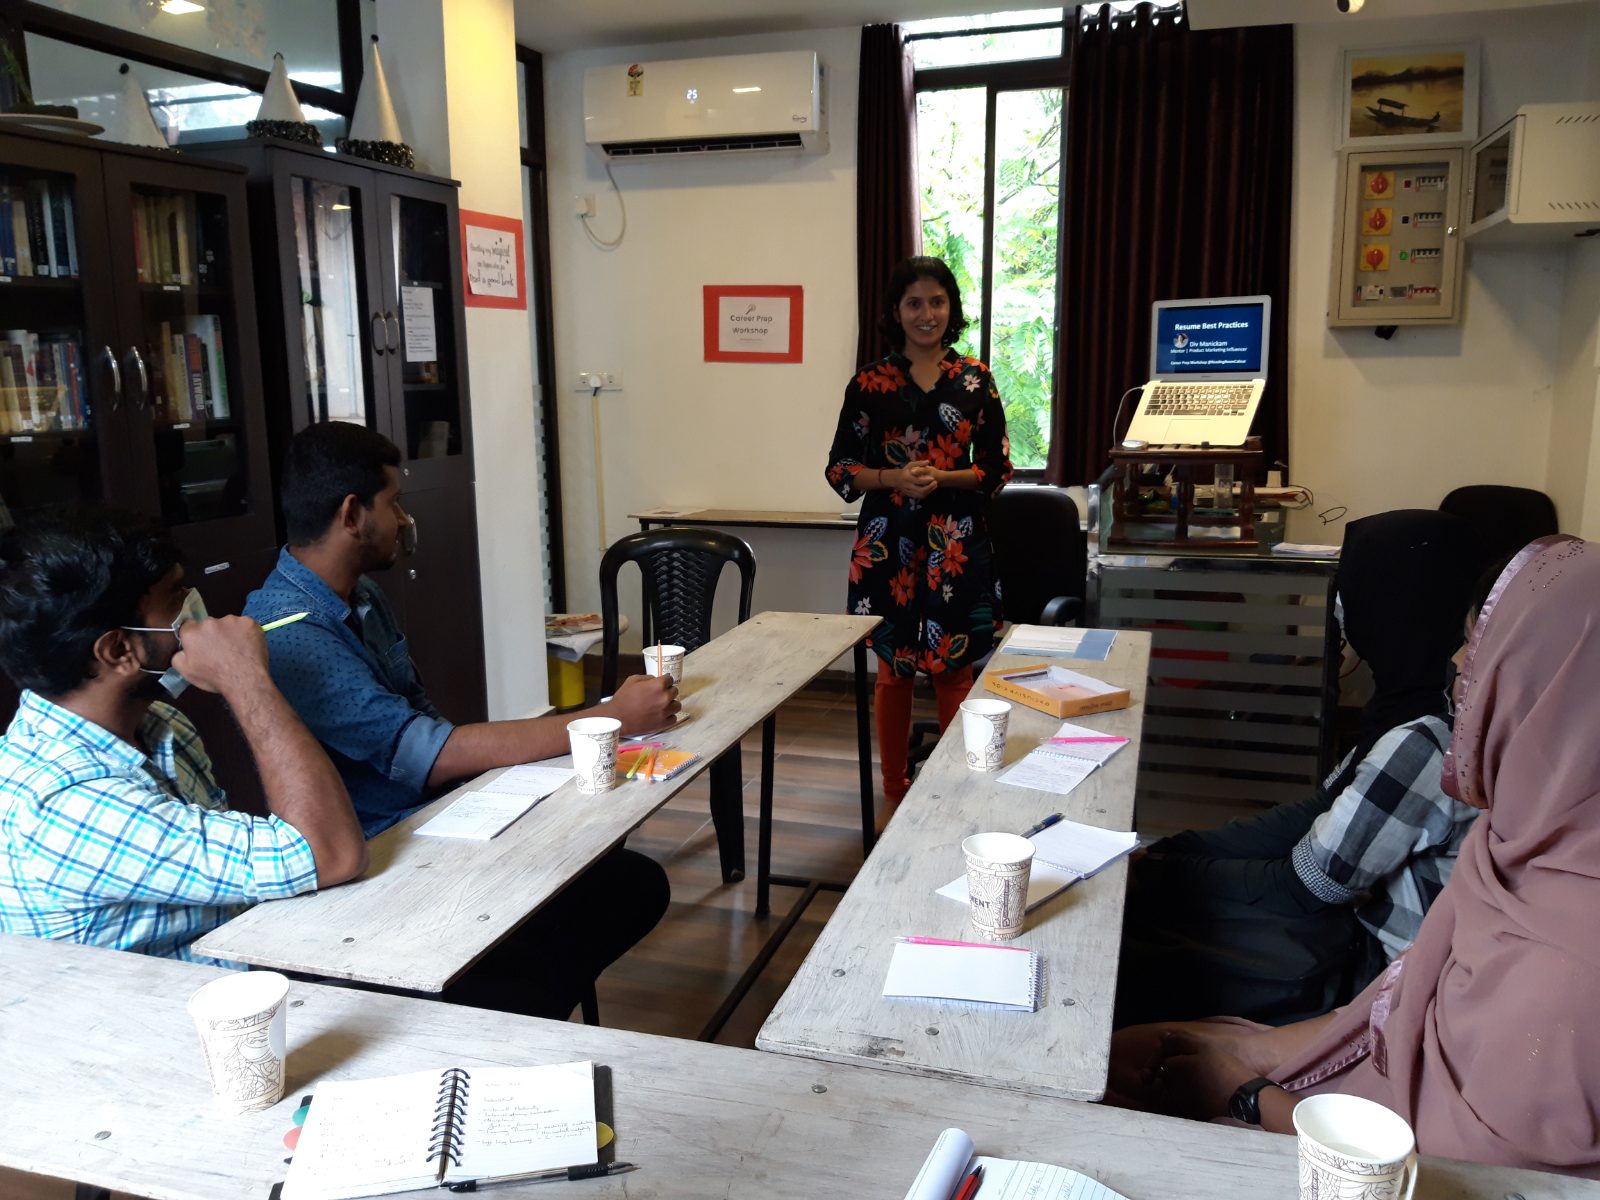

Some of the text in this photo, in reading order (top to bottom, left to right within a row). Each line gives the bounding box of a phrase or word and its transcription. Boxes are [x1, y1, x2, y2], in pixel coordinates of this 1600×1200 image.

[686, 89, 698, 99] 25
[756, 315, 773, 323] Prep
[1174, 321, 1249, 331] Resume Best Practices
[732, 327, 769, 335] Workshop
